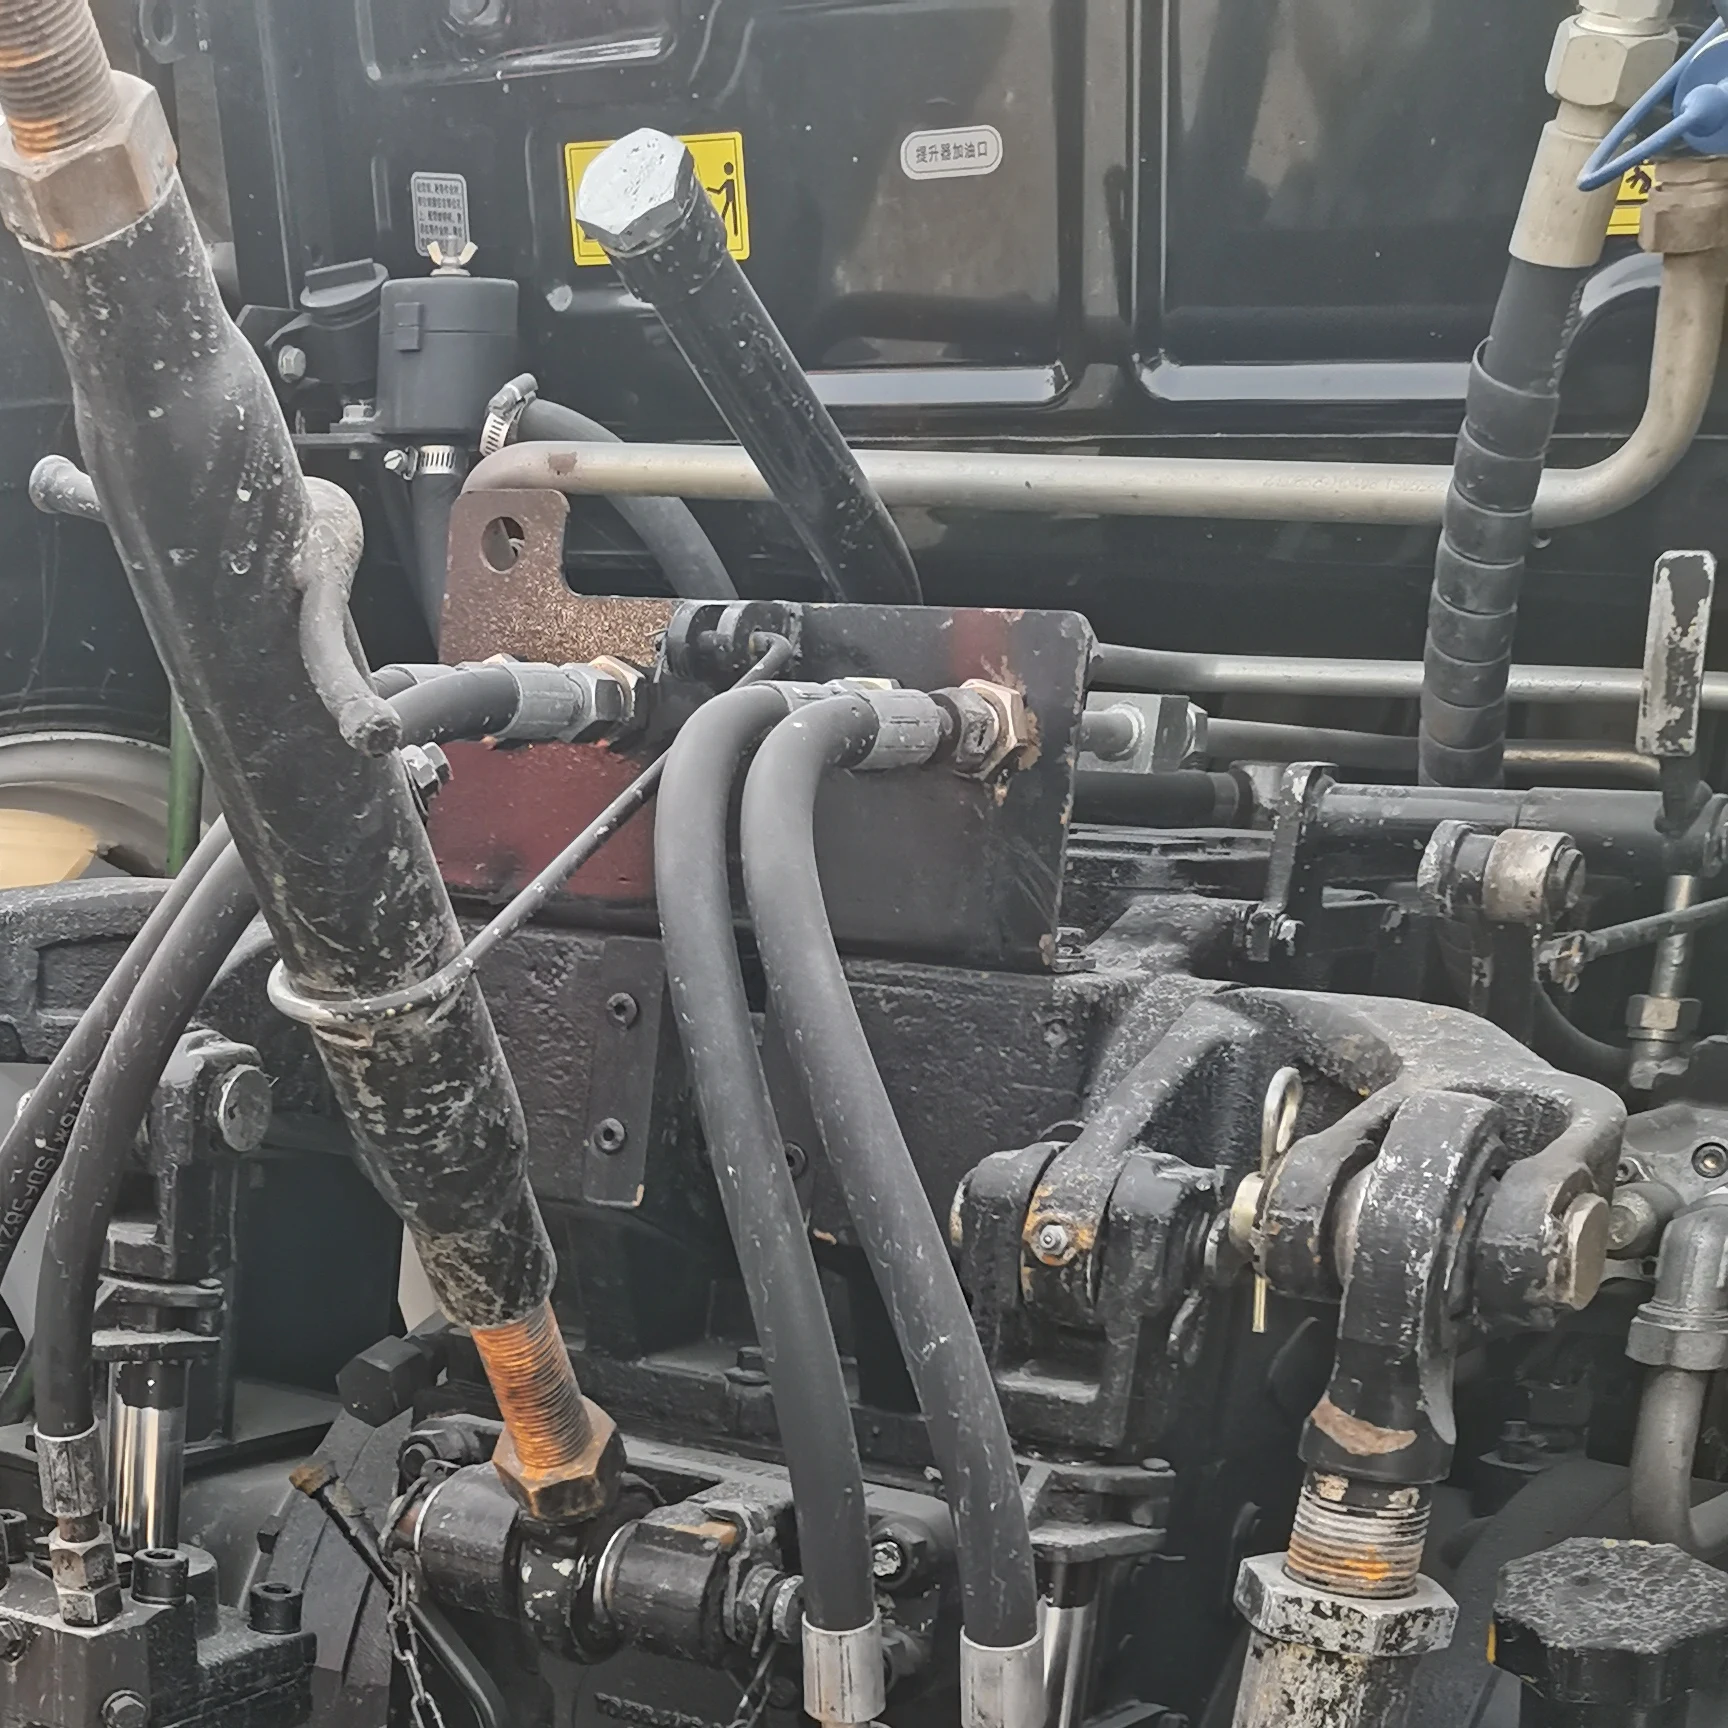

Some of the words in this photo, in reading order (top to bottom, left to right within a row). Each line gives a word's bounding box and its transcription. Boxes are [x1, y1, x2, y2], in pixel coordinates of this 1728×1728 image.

[915, 140, 988, 164] 提升器加油口
